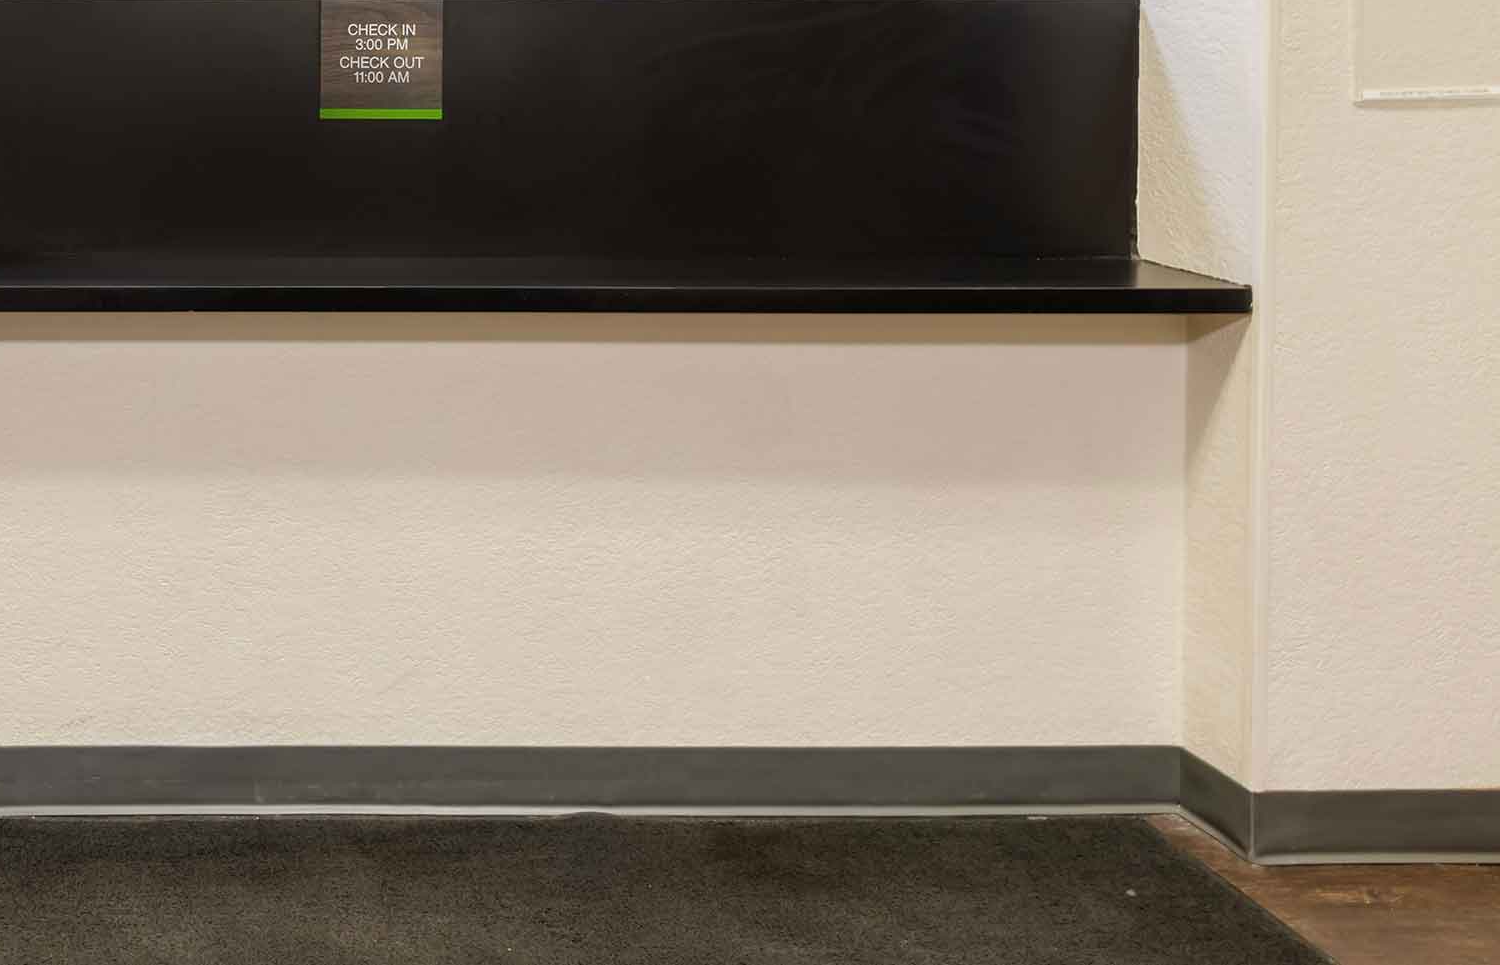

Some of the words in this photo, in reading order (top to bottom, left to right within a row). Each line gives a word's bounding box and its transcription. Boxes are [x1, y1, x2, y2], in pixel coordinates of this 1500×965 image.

[347, 23, 398, 36] CHECK
[402, 23, 416, 36] IN
[355, 38, 383, 50] 3:00
[387, 38, 409, 50] PM
[340, 56, 390, 69] CHECK
[393, 56, 424, 69] OUT
[354, 71, 384, 83] 11:00
[388, 71, 410, 83] AM
